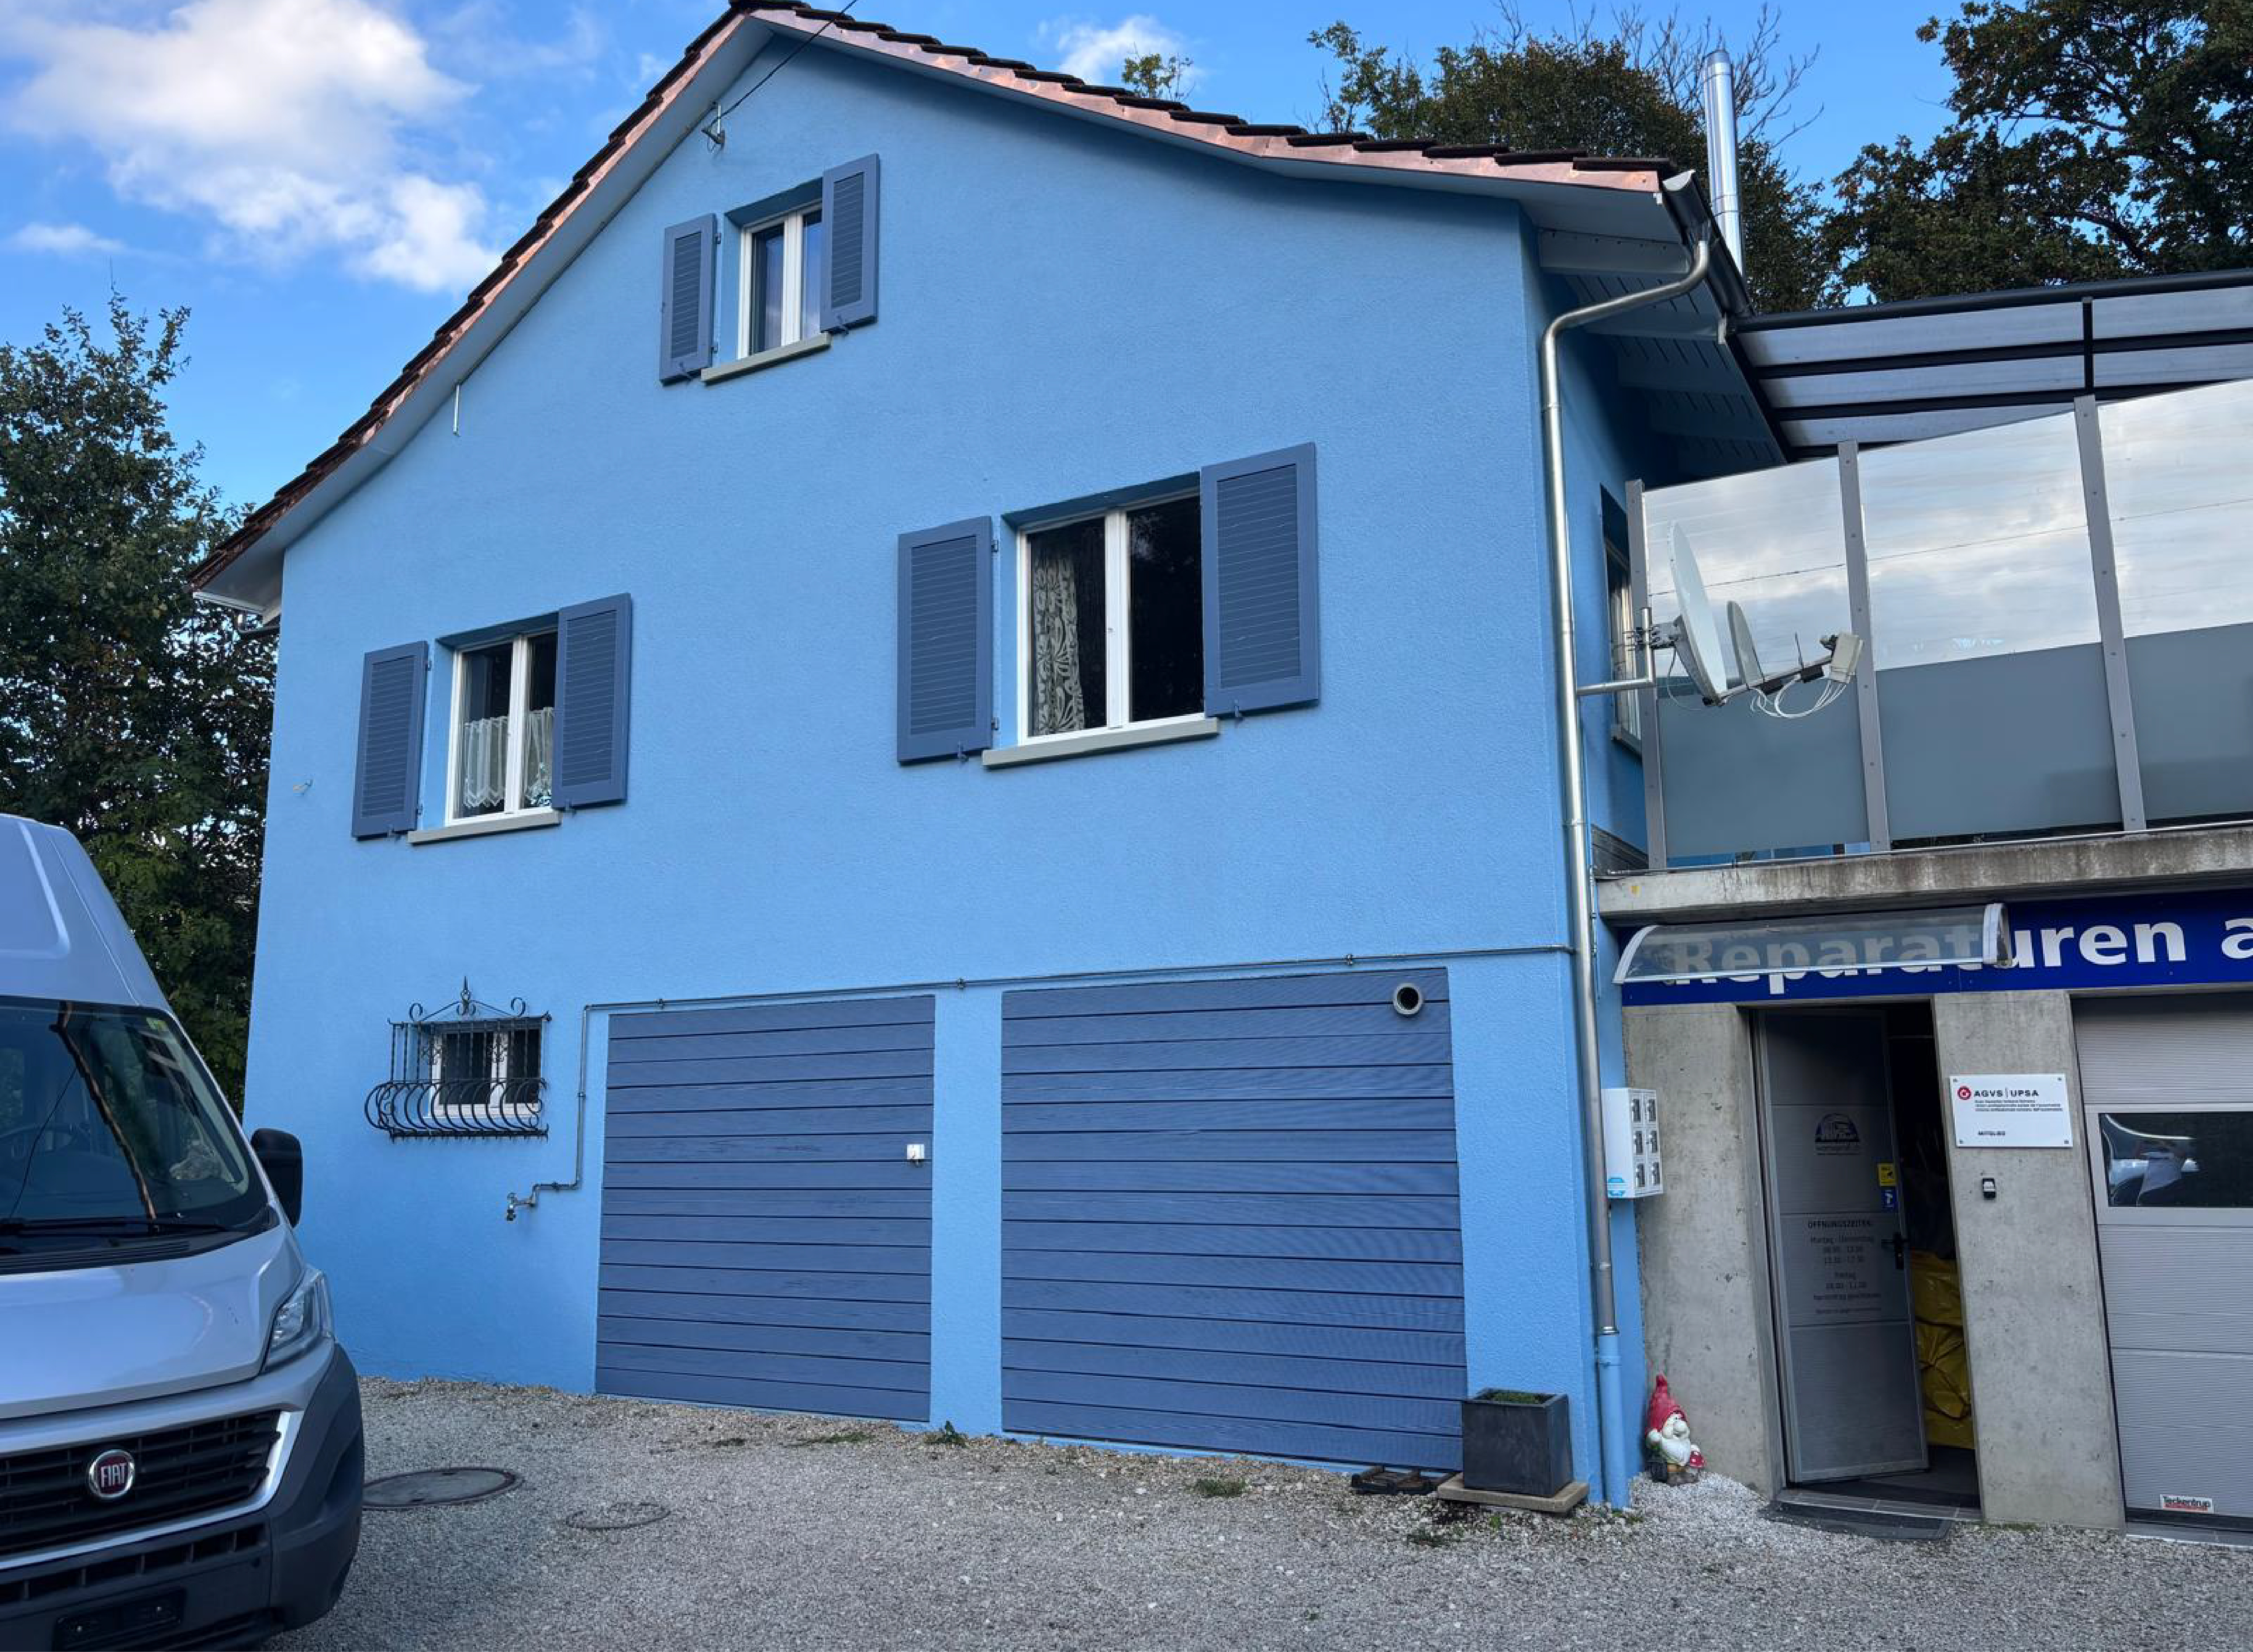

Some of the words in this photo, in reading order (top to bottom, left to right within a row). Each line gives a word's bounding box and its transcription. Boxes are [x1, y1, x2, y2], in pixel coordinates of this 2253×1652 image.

[1673, 922, 2186, 994] Reparaturen
[1974, 1089, 2003, 1097] AGVS
[2010, 1089, 2039, 1097] UPSA
[101, 1463, 127, 1488] FIAT
